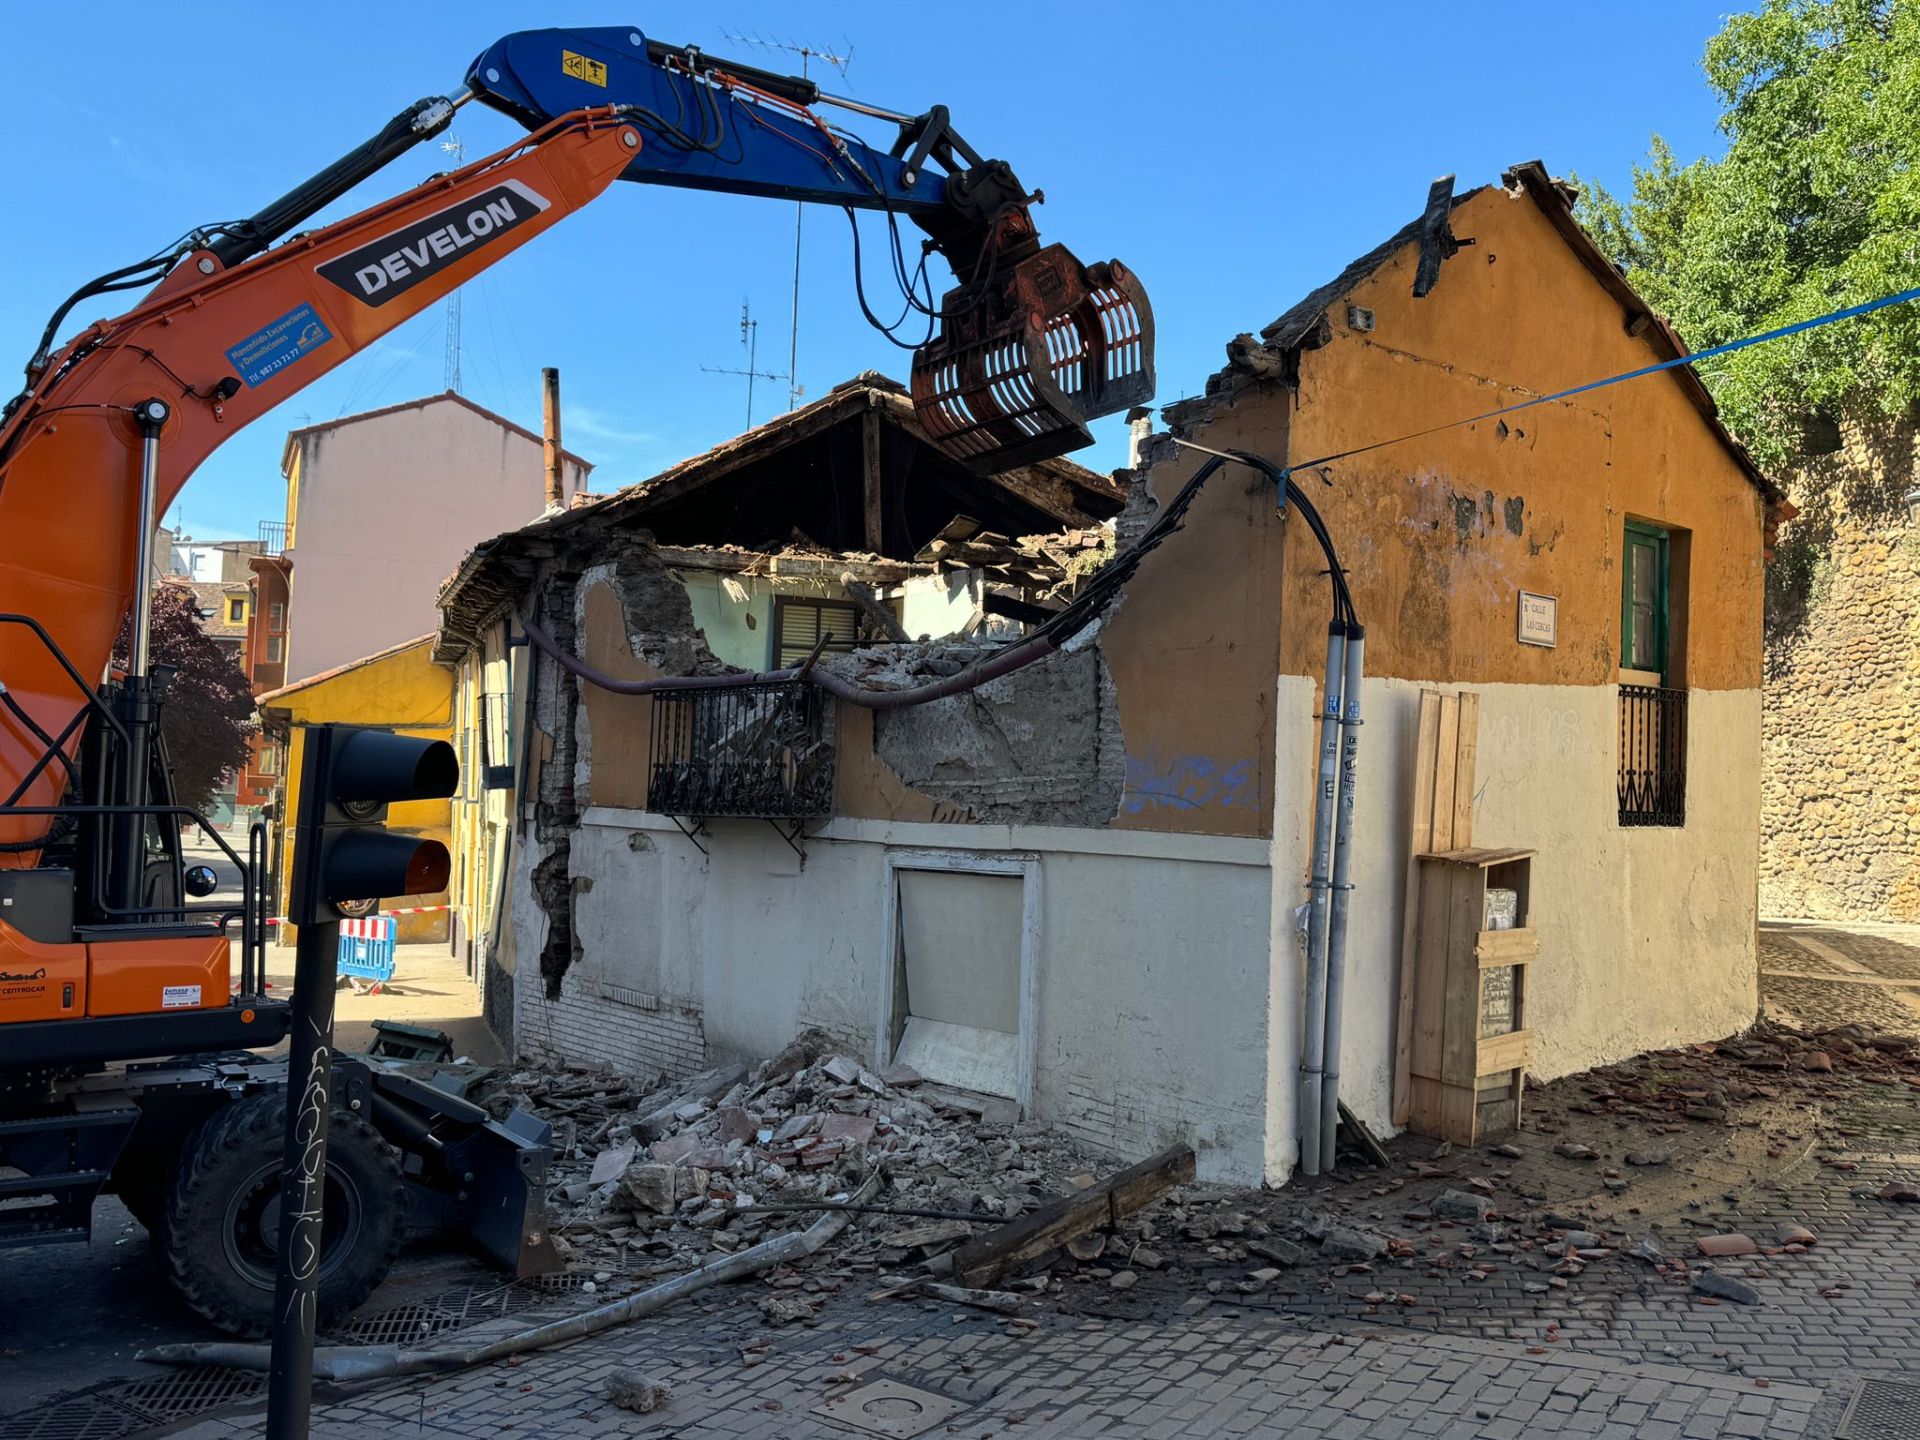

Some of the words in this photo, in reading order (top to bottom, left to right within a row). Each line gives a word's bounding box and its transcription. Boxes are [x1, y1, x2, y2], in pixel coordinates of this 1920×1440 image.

[354, 196, 517, 296] DEVELON
[266, 308, 310, 337] Excavaciones
[242, 334, 289, 365] Demoliciones
[260, 365, 273, 377] 987
[273, 360, 282, 368] 23
[290, 348, 299, 357] 77
[1531, 603, 1546, 615] CALLE
[1526, 619, 1535, 630] LAS
